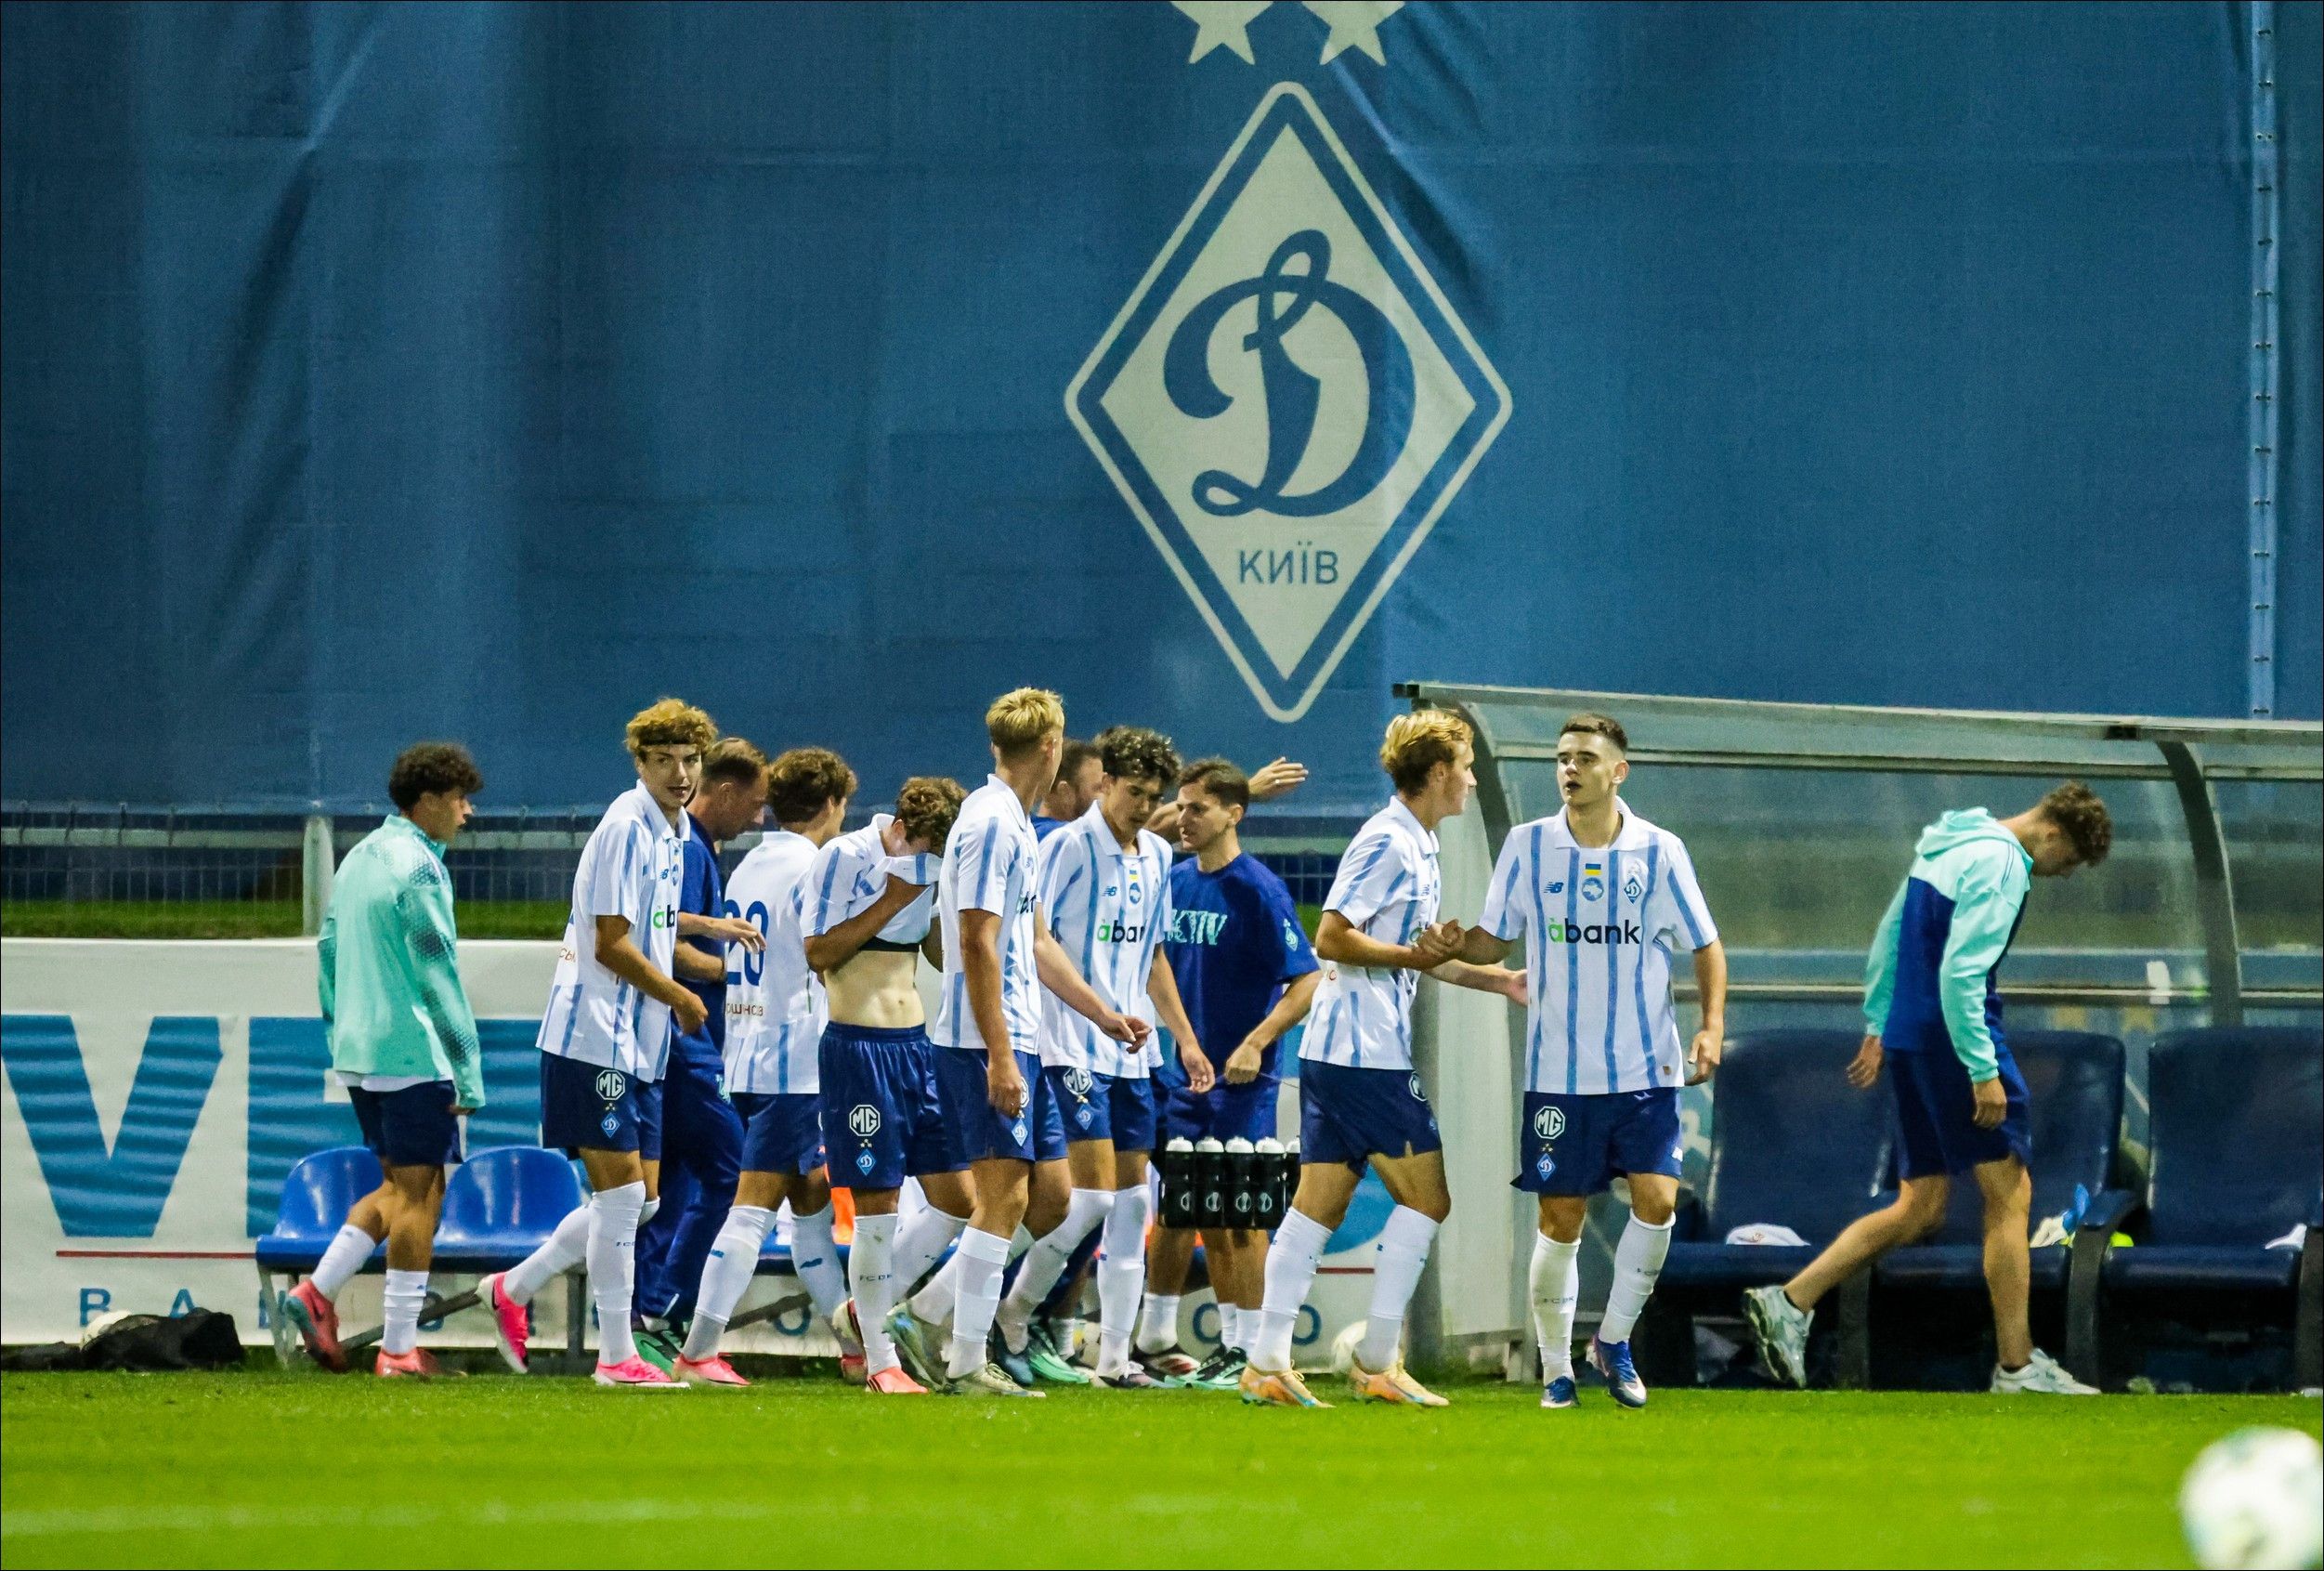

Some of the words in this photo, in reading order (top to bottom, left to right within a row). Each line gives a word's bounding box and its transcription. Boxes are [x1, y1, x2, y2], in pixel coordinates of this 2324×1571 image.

[1238, 541, 1339, 586] КИЇВ
[598, 1072, 623, 1097] MG
[852, 1107, 878, 1133] MG
[1537, 1109, 1562, 1136] MG
